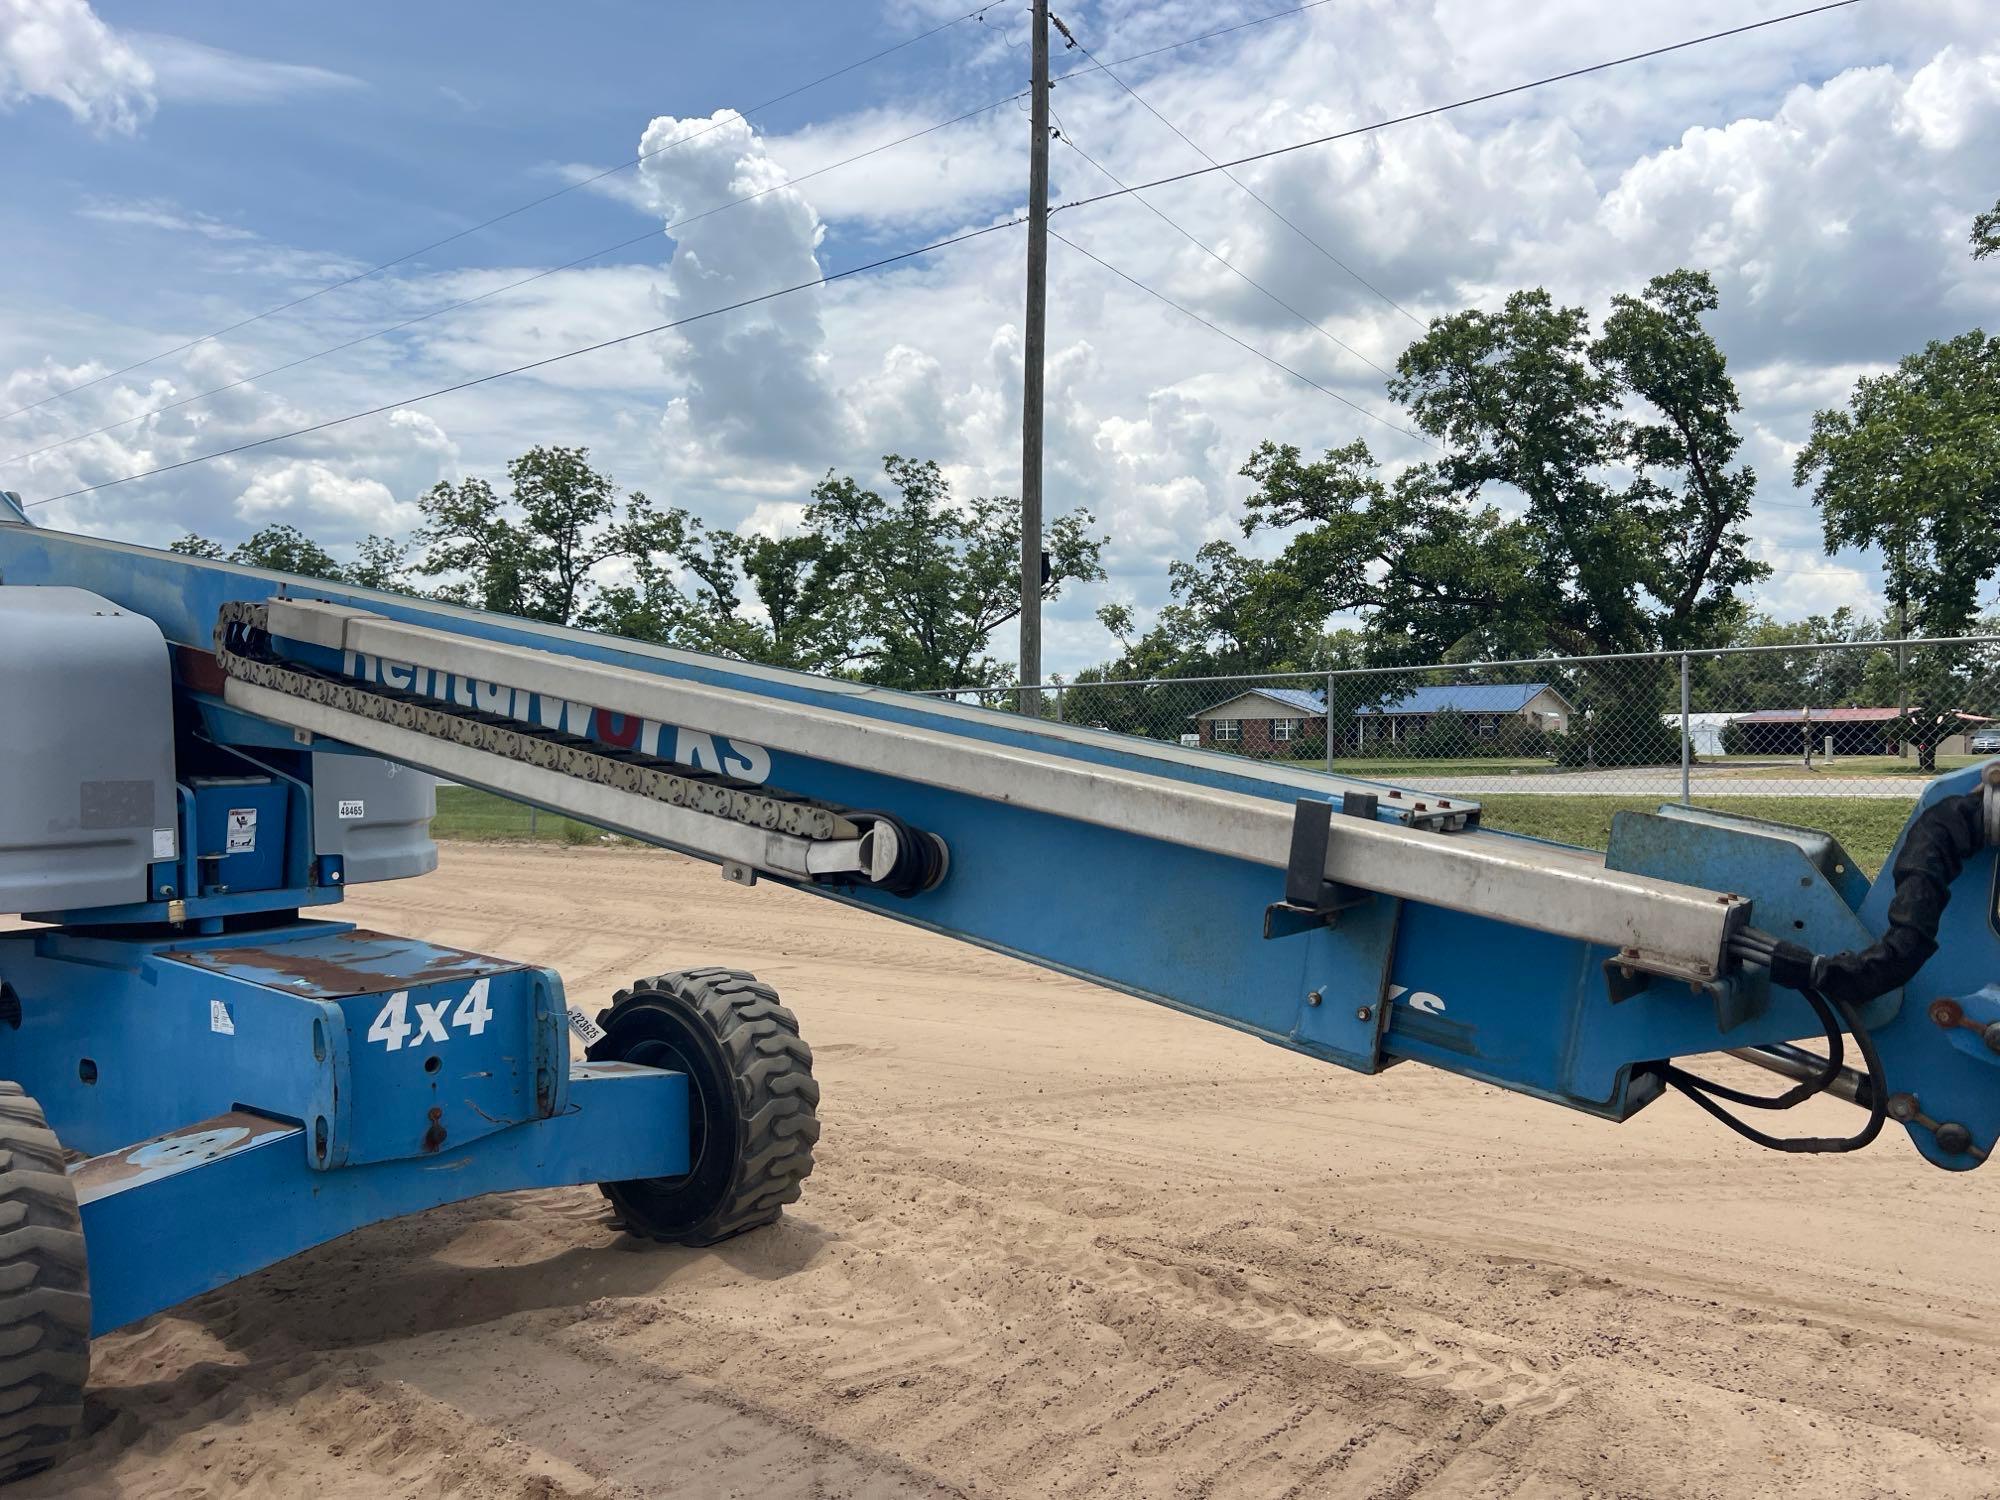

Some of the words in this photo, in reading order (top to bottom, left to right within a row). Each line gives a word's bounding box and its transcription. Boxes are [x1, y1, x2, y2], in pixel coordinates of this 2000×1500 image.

[340, 806, 363, 816] 48465
[367, 977, 493, 1051] 4x4
[572, 1012, 600, 1039] 223625
